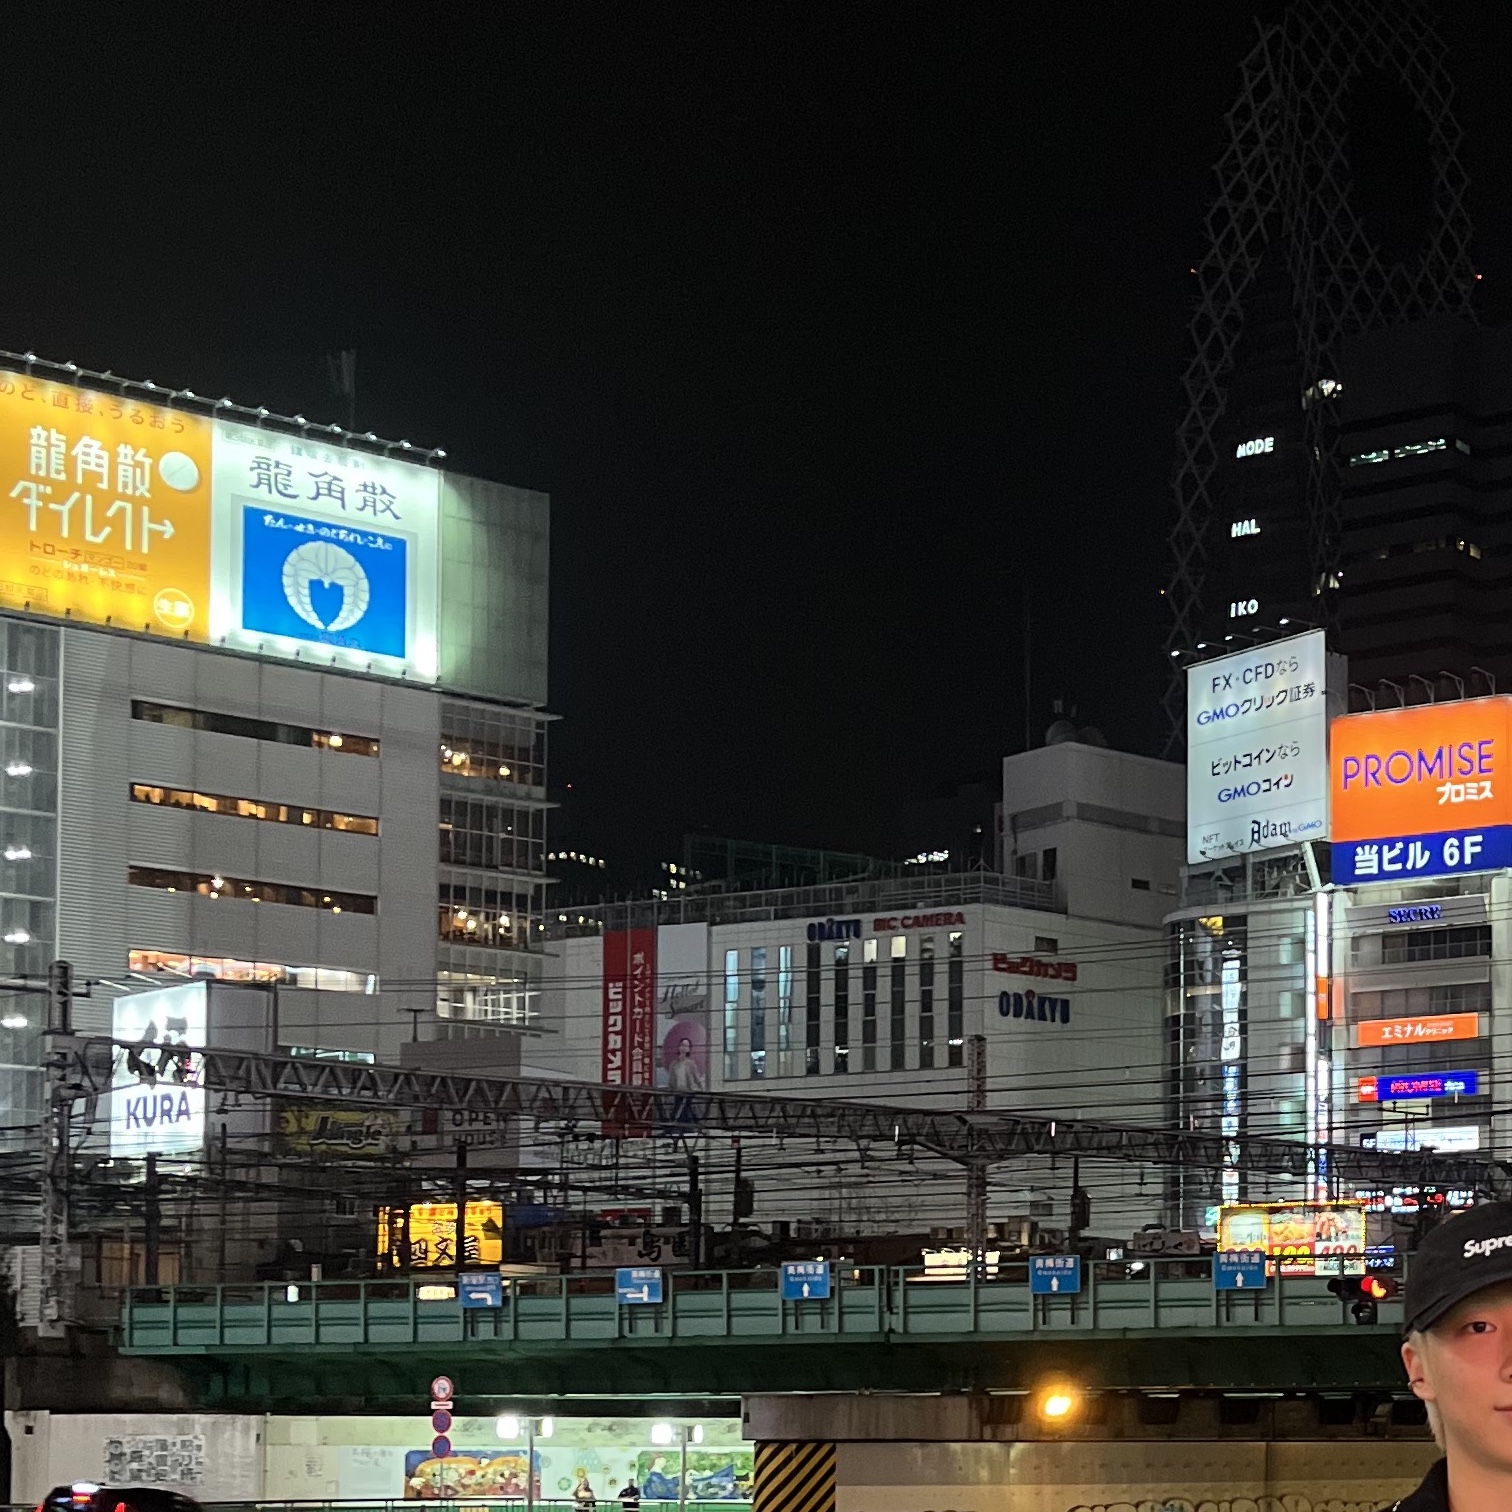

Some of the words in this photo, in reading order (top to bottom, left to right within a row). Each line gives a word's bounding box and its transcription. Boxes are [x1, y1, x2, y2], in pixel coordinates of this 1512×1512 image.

[30, 425, 153, 498] 龍角散
[1236, 436, 1275, 459] MODE
[249, 455, 402, 521] 龍角散
[9, 479, 175, 554] ダイレクト
[1231, 518, 1261, 538] HAL
[1196, 682, 1316, 726] GMOクリック証券
[1211, 740, 1300, 777] ビットコインなら
[1342, 738, 1495, 791] PROMISE
[1217, 773, 1294, 803] GMOコイン
[1436, 780, 1494, 806] プロミス
[1248, 819, 1292, 850] Adam
[1353, 841, 1431, 877] 当ビル
[1442, 835, 1484, 868] 6F
[873, 917, 899, 932] BIC
[901, 911, 966, 930] CAMERA
[998, 988, 1071, 1025] ODAKYU
[125, 1090, 192, 1130] KURA
